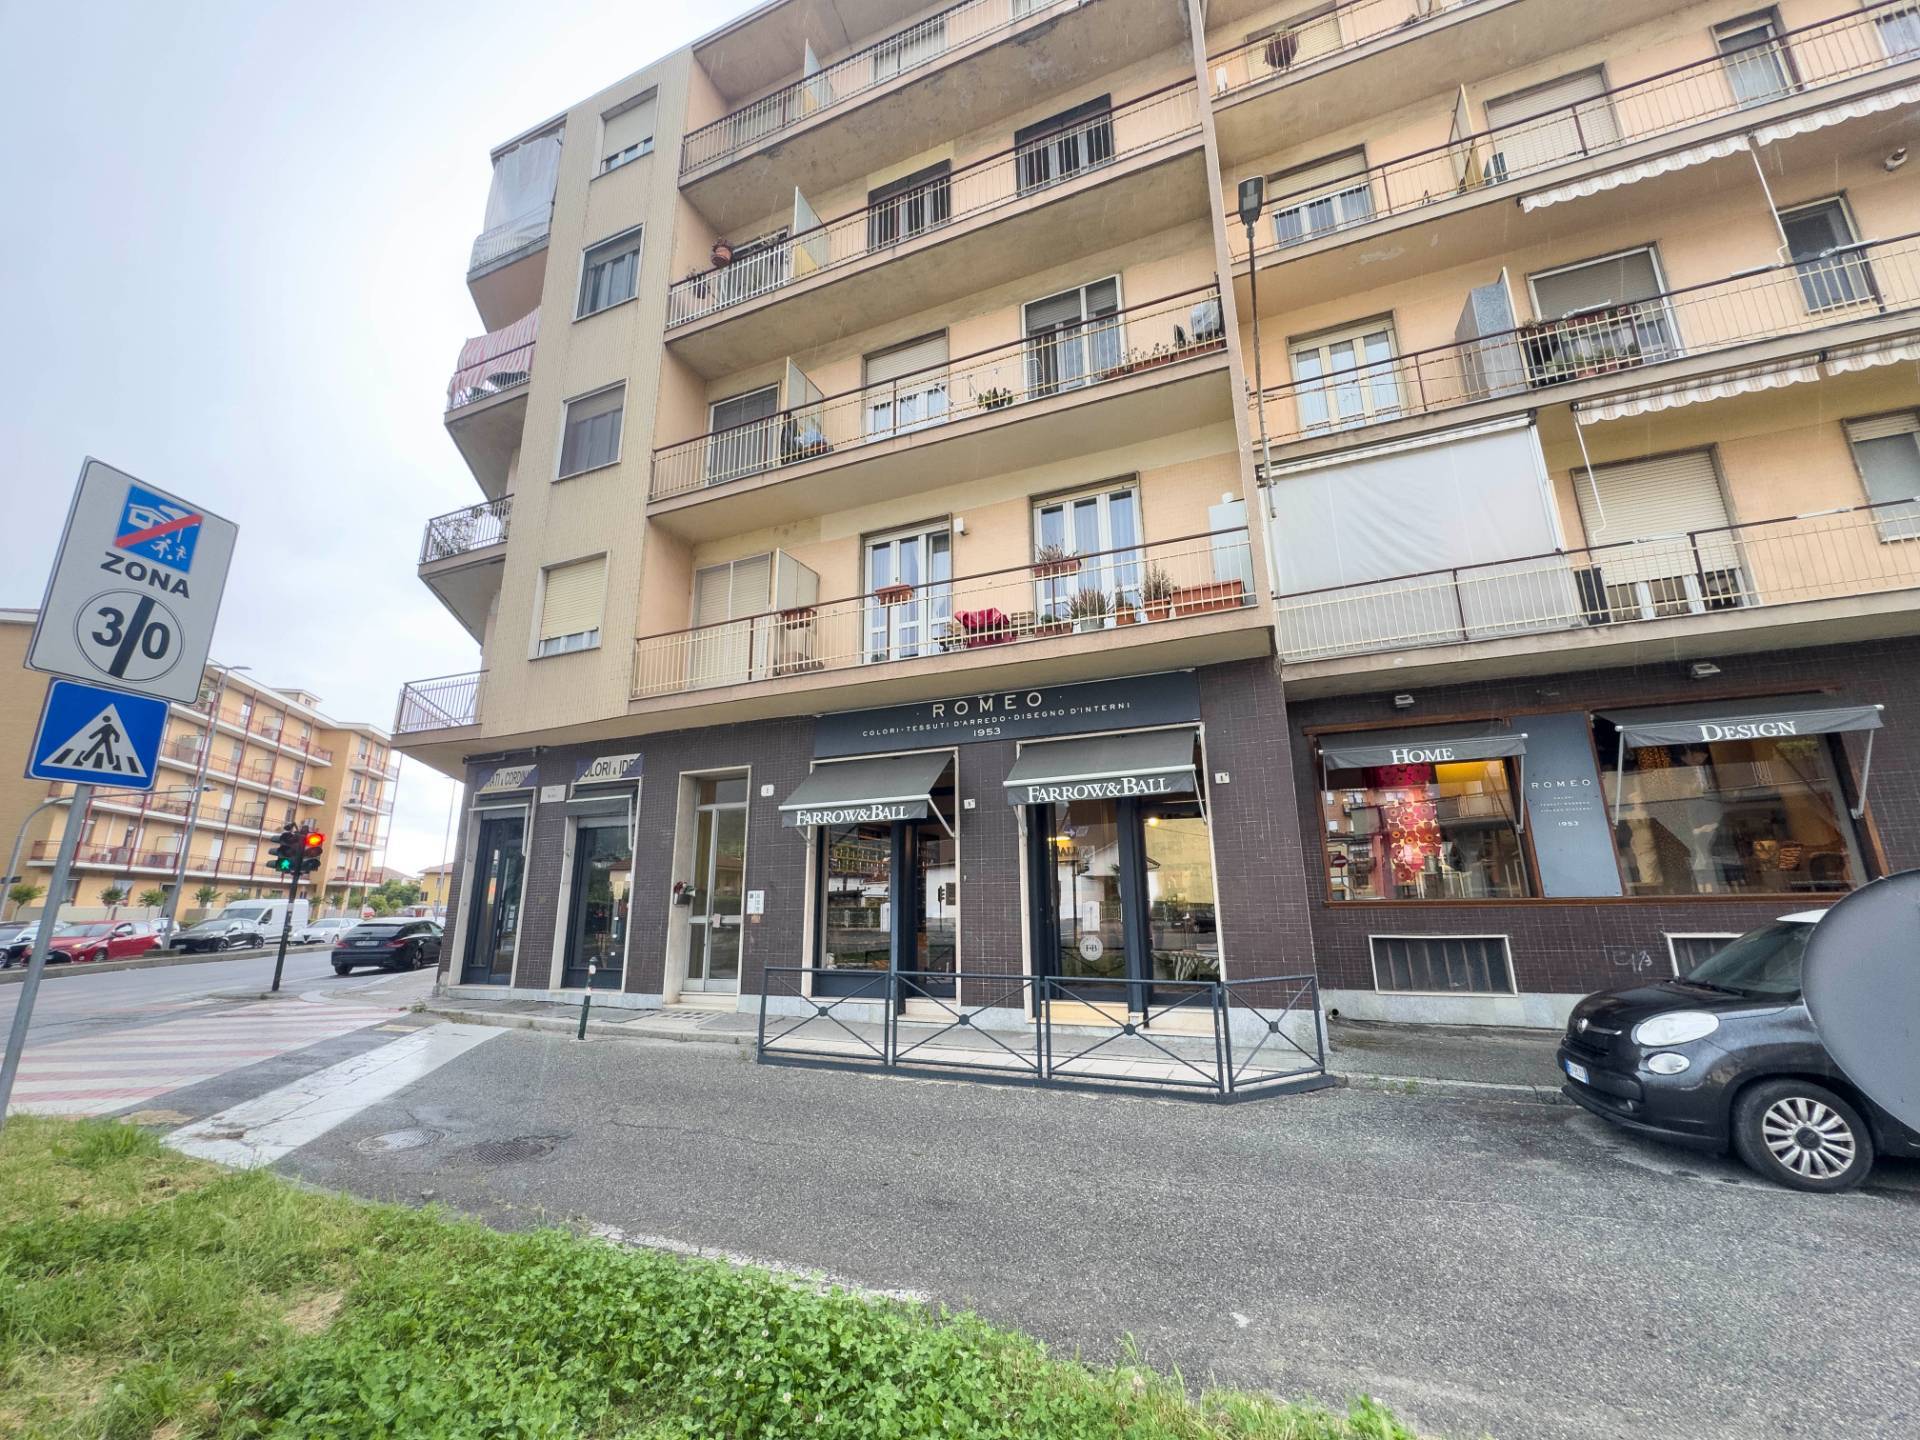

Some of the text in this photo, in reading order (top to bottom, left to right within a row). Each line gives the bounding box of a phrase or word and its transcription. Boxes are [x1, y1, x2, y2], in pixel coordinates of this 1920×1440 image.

[100, 551, 190, 599] ZONA
[932, 692, 1042, 718] ROMEO
[973, 727, 1001, 737] 1953
[1697, 720, 1797, 742] DESIGN
[1390, 747, 1455, 765] HOME
[1027, 777, 1171, 803] FARROW&BALL
[1531, 779, 1591, 790] ROMEO
[796, 804, 909, 826] FARROW&BALL
